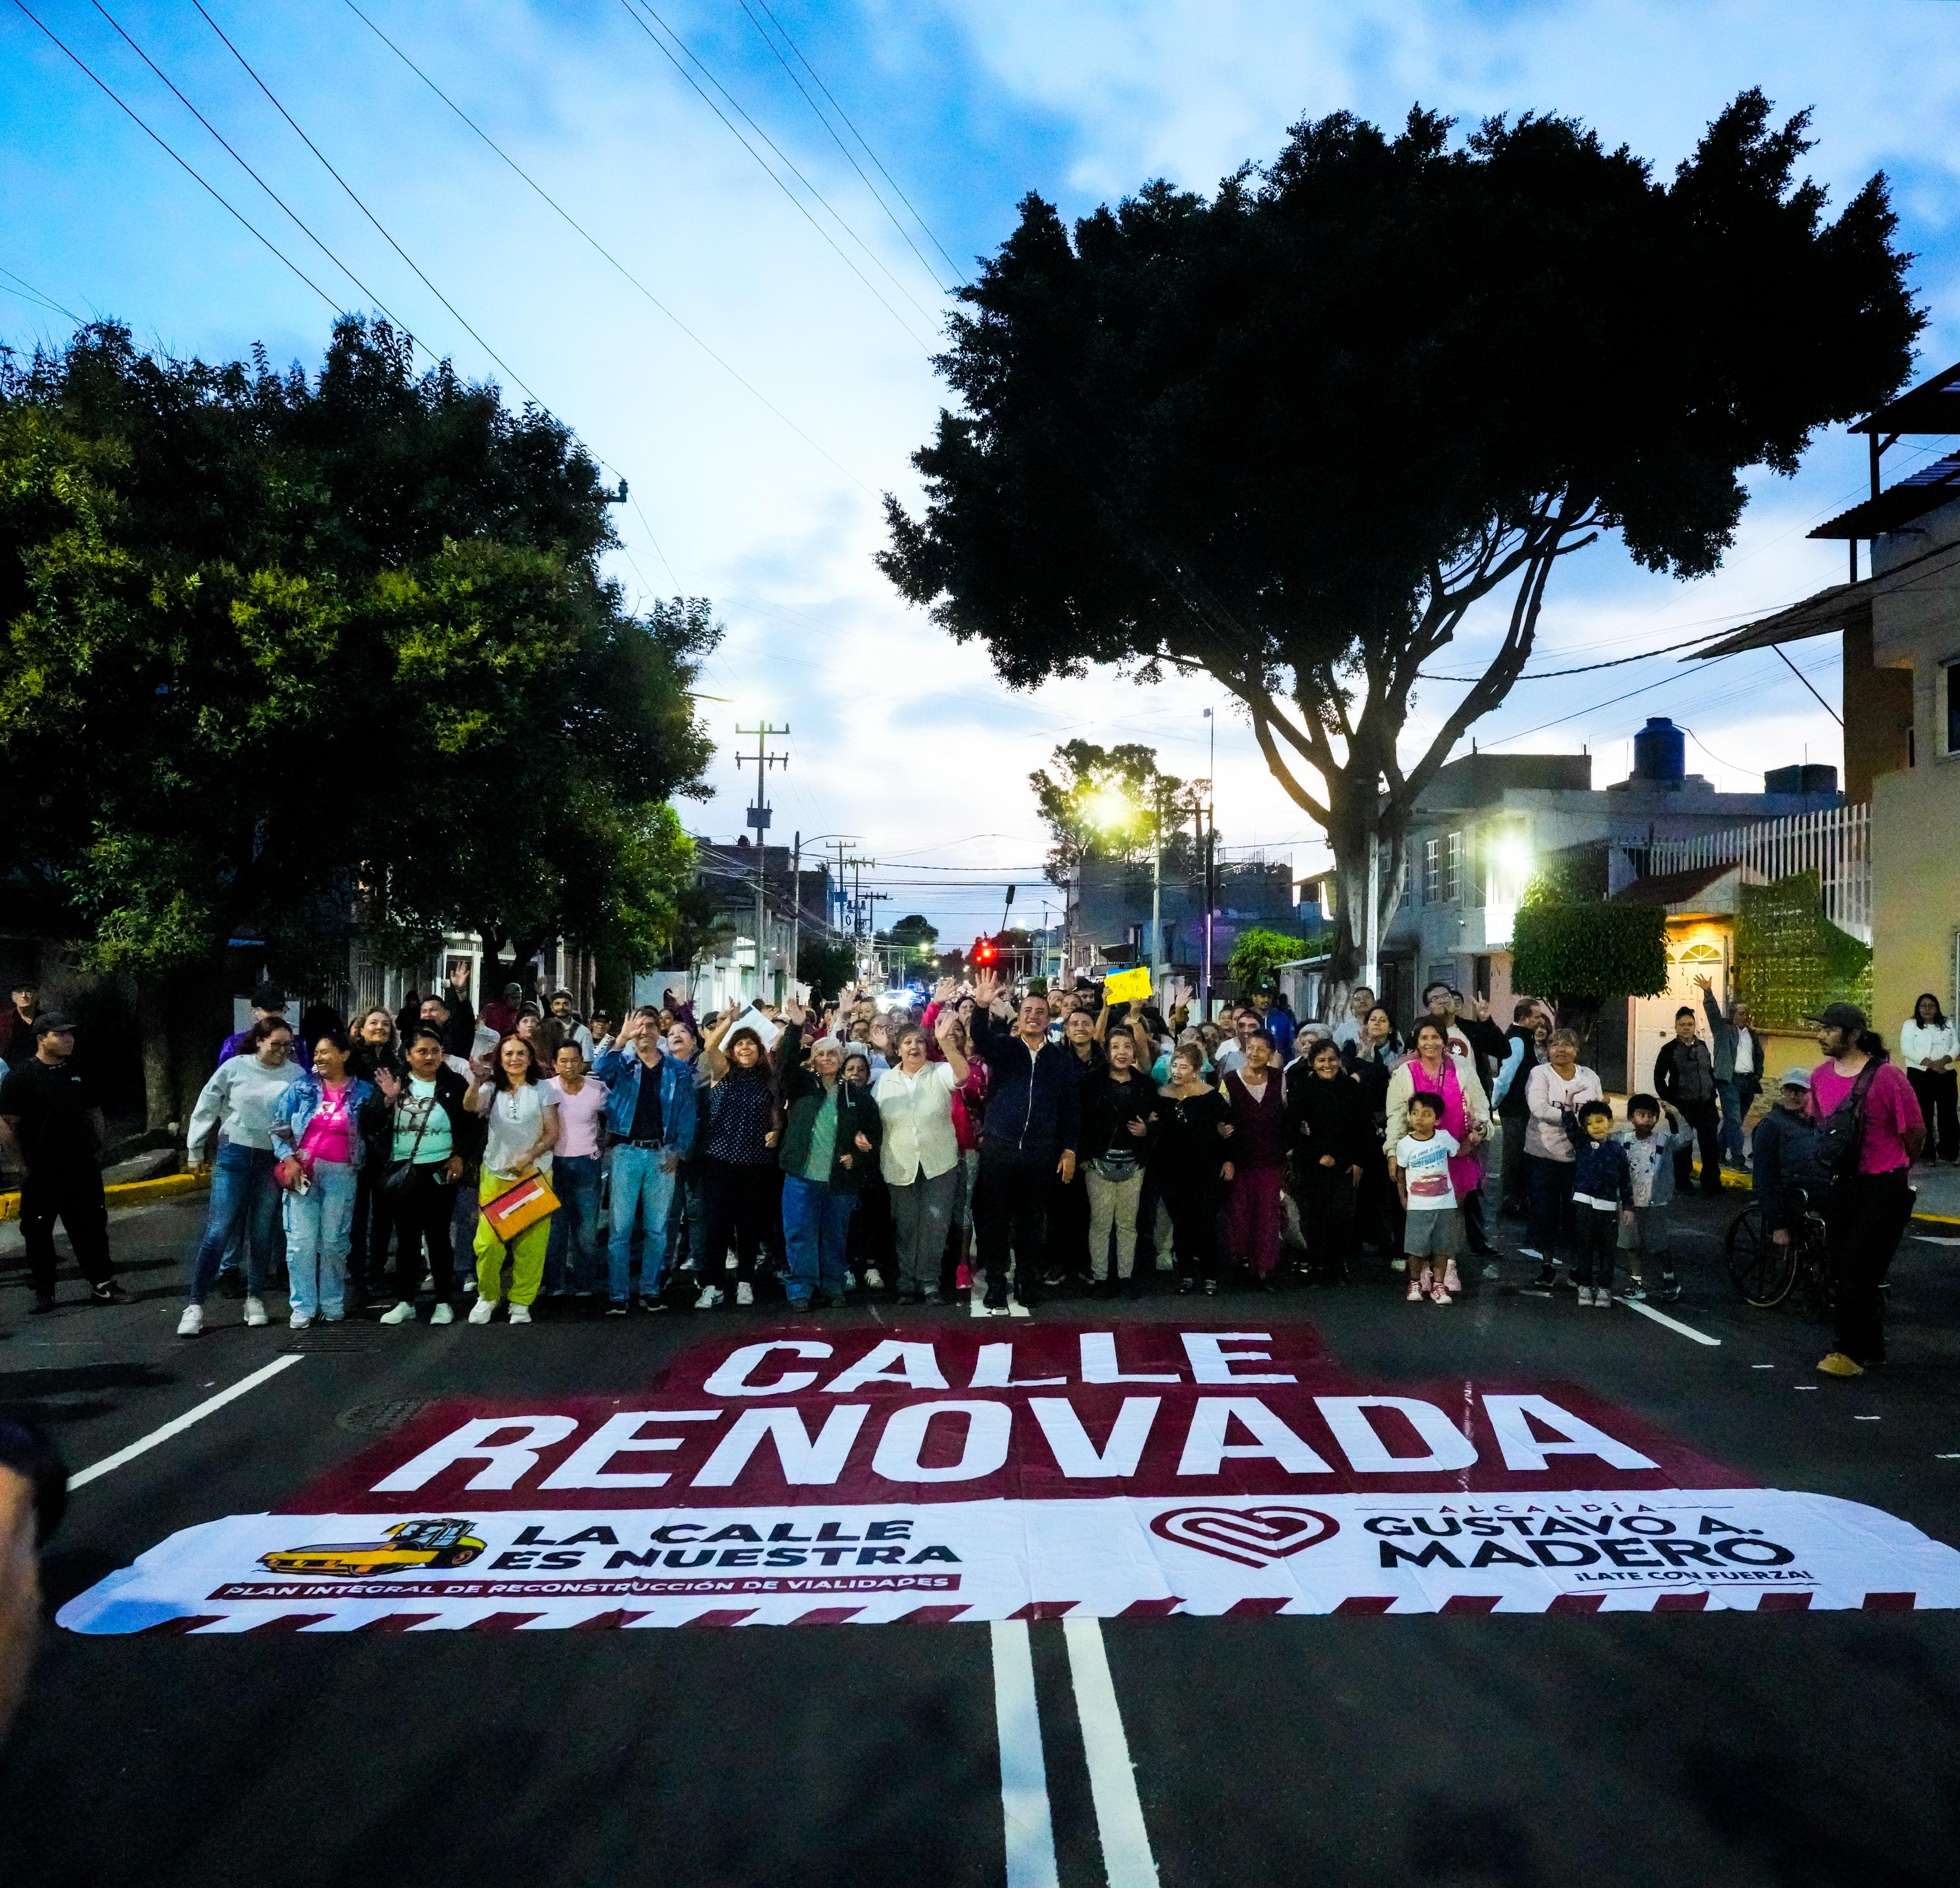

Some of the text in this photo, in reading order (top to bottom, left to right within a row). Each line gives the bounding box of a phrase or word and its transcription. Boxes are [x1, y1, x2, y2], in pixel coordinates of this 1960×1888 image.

[703, 1332, 1298, 1397] CALLE
[369, 1395, 1662, 1492] RENOVADA
[1439, 1502, 1658, 1513] ALCALDÍA
[511, 1520, 914, 1546] LA CALLE
[1363, 1515, 1764, 1536] GUSTAVO A.
[487, 1545, 963, 1570] ES NUESTRA
[1380, 1537, 1796, 1568] MADERO
[223, 1577, 949, 1596] PLAN INTEGRAL DE RECONSTRUCCIÓN DE VIALIDADES
[1574, 1570, 1814, 1581] ¡LATE CON FUERZA!
